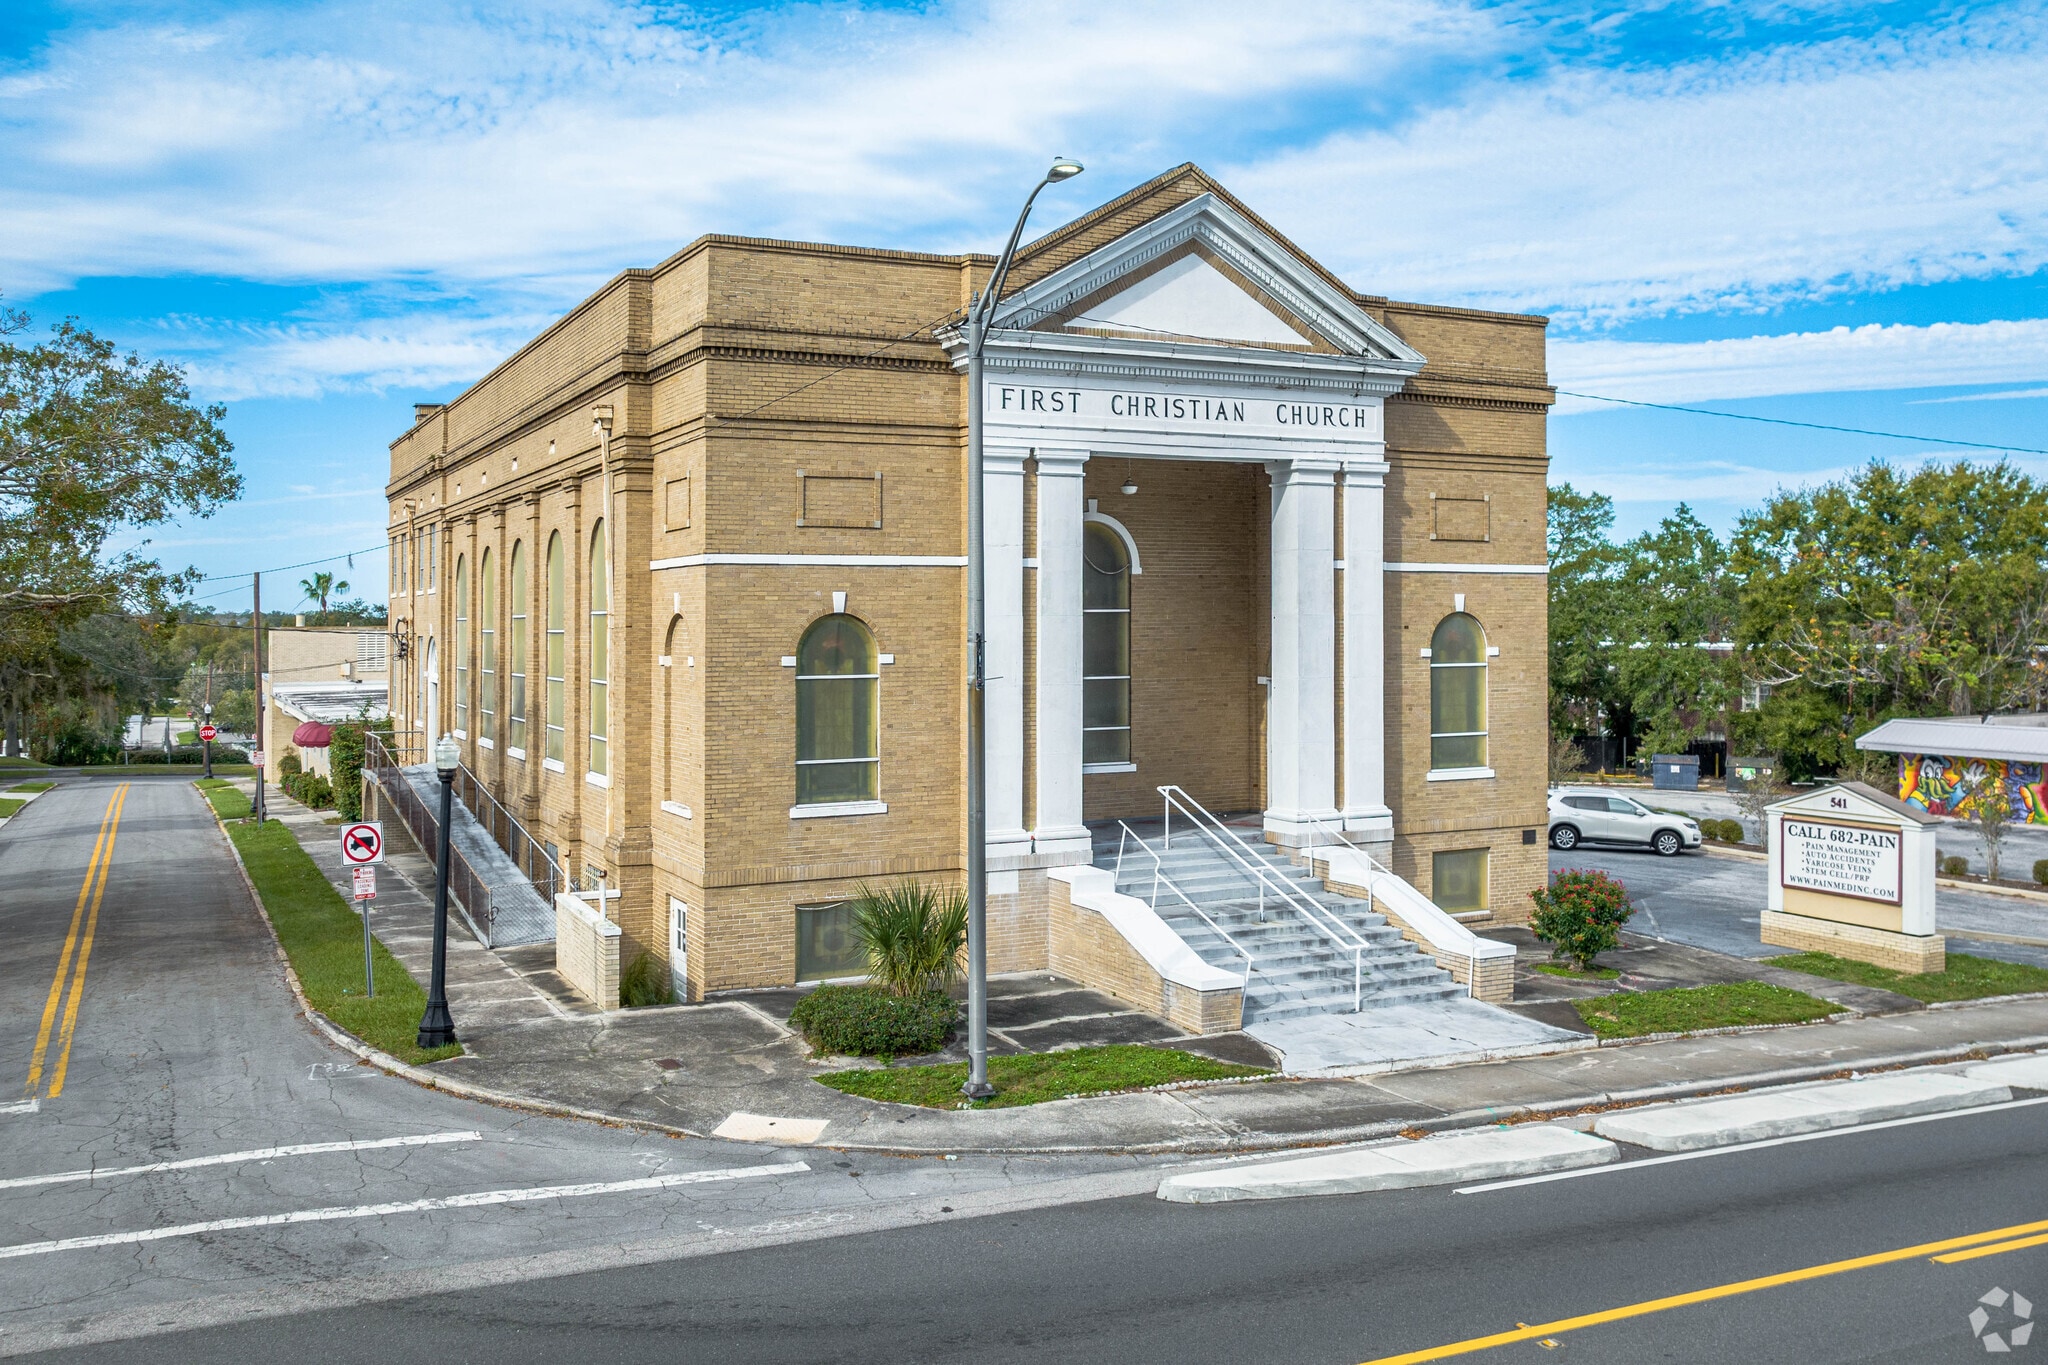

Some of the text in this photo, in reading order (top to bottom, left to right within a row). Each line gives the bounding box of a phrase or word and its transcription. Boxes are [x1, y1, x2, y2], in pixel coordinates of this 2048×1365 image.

[1001, 388, 1366, 428] FIRST CHRISTIAN CHURCH
[1830, 797, 1847, 809] 541
[1788, 824, 1896, 849] CALL 682-PAIN
[1806, 842, 1881, 858] PAIN MANAGEMENT
[1806, 851, 1876, 866] AUTO ACCIDENTS
[1806, 858, 1872, 874] VARICOSE VEINS
[1806, 866, 1870, 882] STEM CELL/PRP
[1789, 875, 1895, 898] WWW.PAINMEDINC.COM
